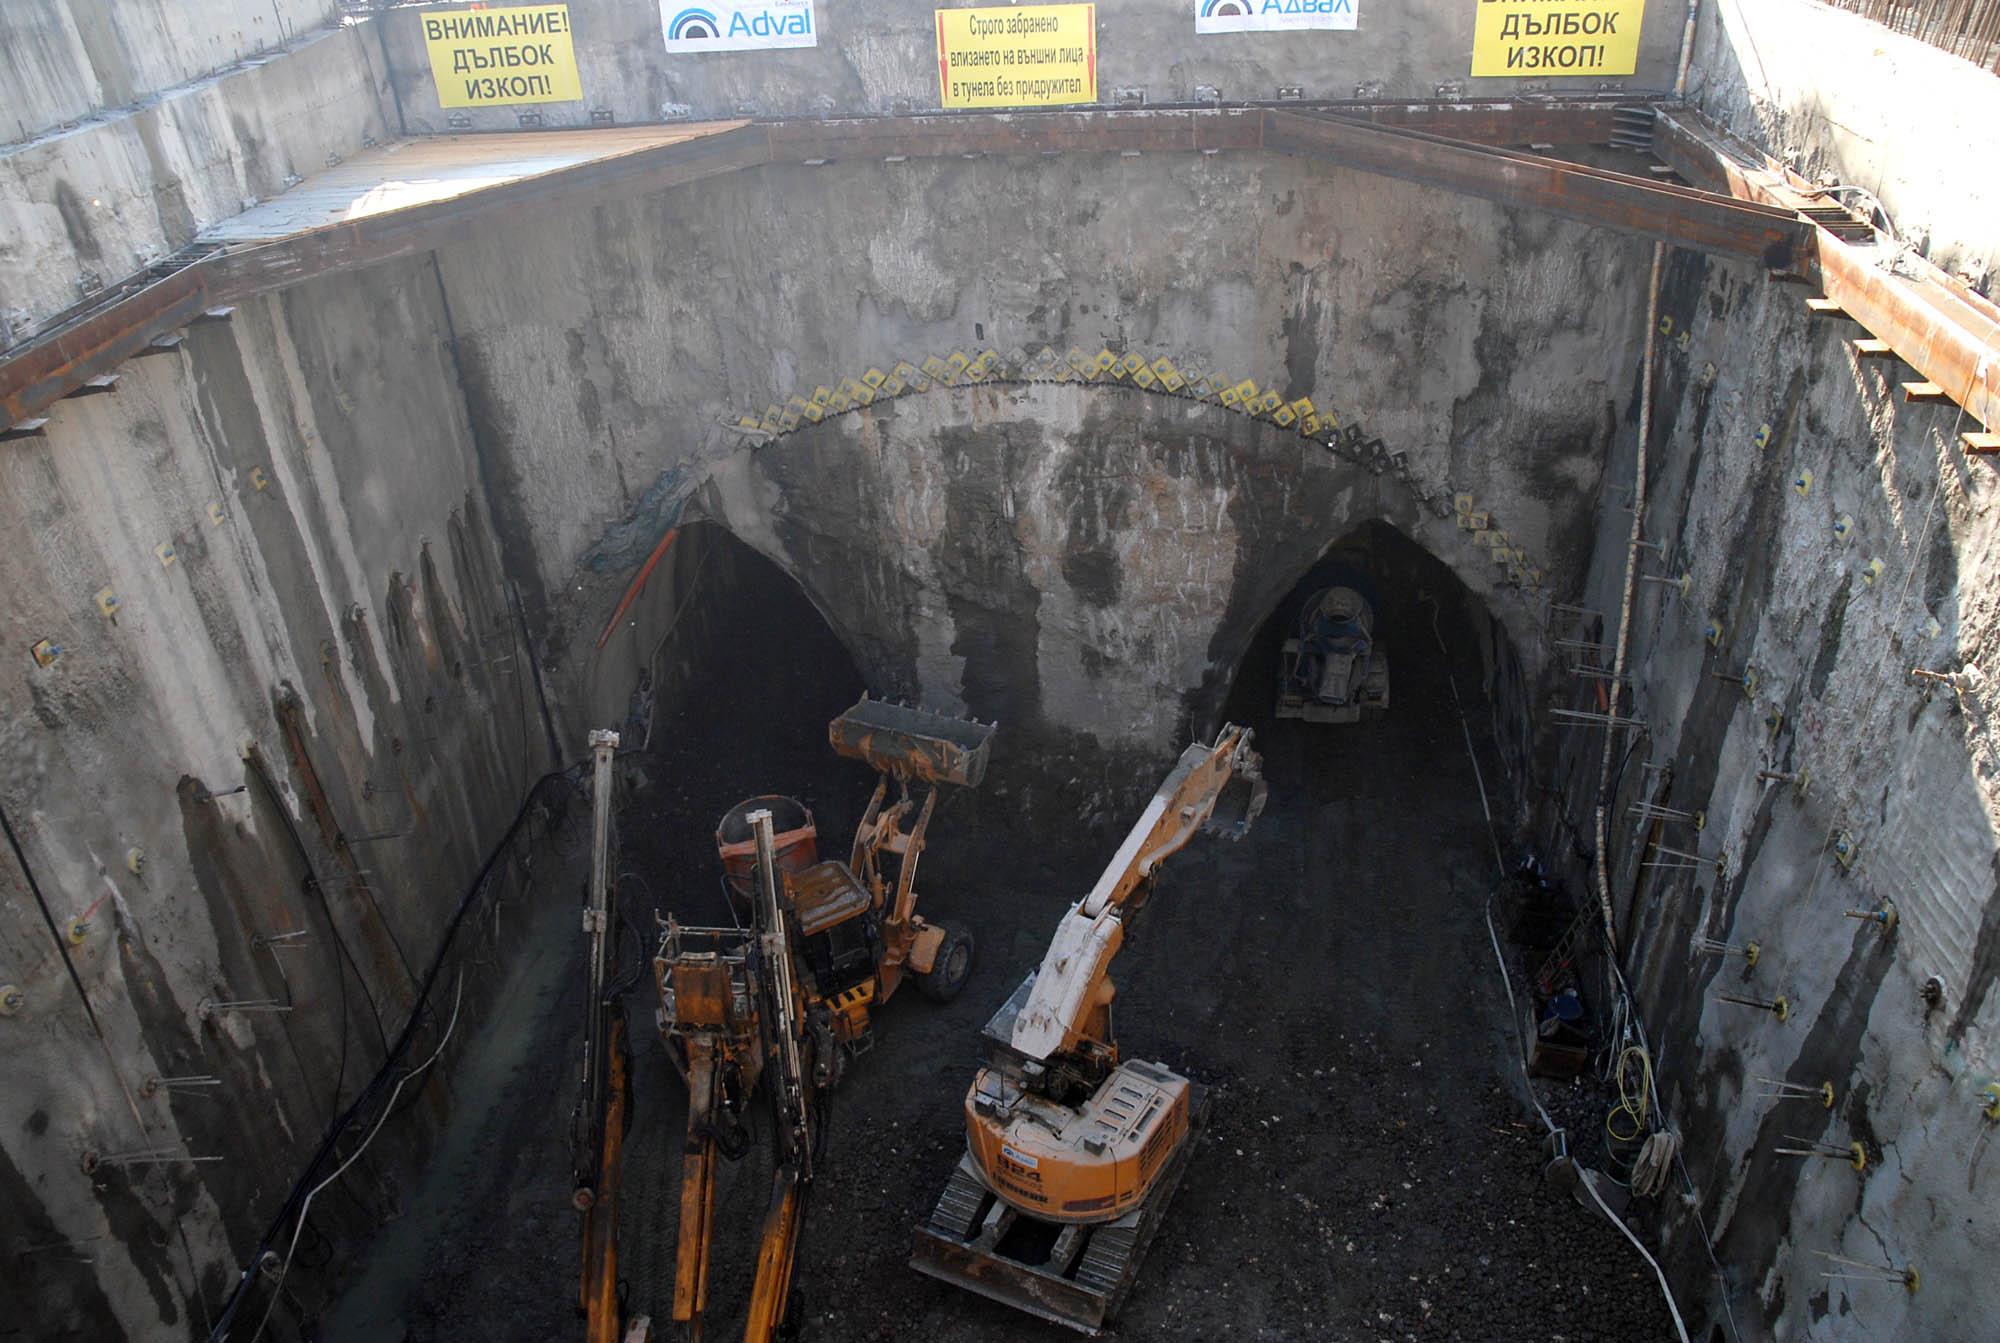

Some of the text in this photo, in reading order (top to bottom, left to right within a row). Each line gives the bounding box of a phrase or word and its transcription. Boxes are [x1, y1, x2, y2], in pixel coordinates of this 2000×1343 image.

[426, 11, 569, 40] ВНИМАНИЕ!
[728, 8, 811, 37] Adval
[969, 12, 1059, 40] Строго забранено
[1500, 11, 1619, 40] ДЪЛБОК
[453, 44, 554, 74] ДЪЛБОК
[951, 47, 1084, 67] влизането на външни лица
[1506, 45, 1604, 68] ИЗКОП!
[465, 75, 552, 99] ИЗКОП!
[953, 75, 1081, 102] в тунела без придружител
